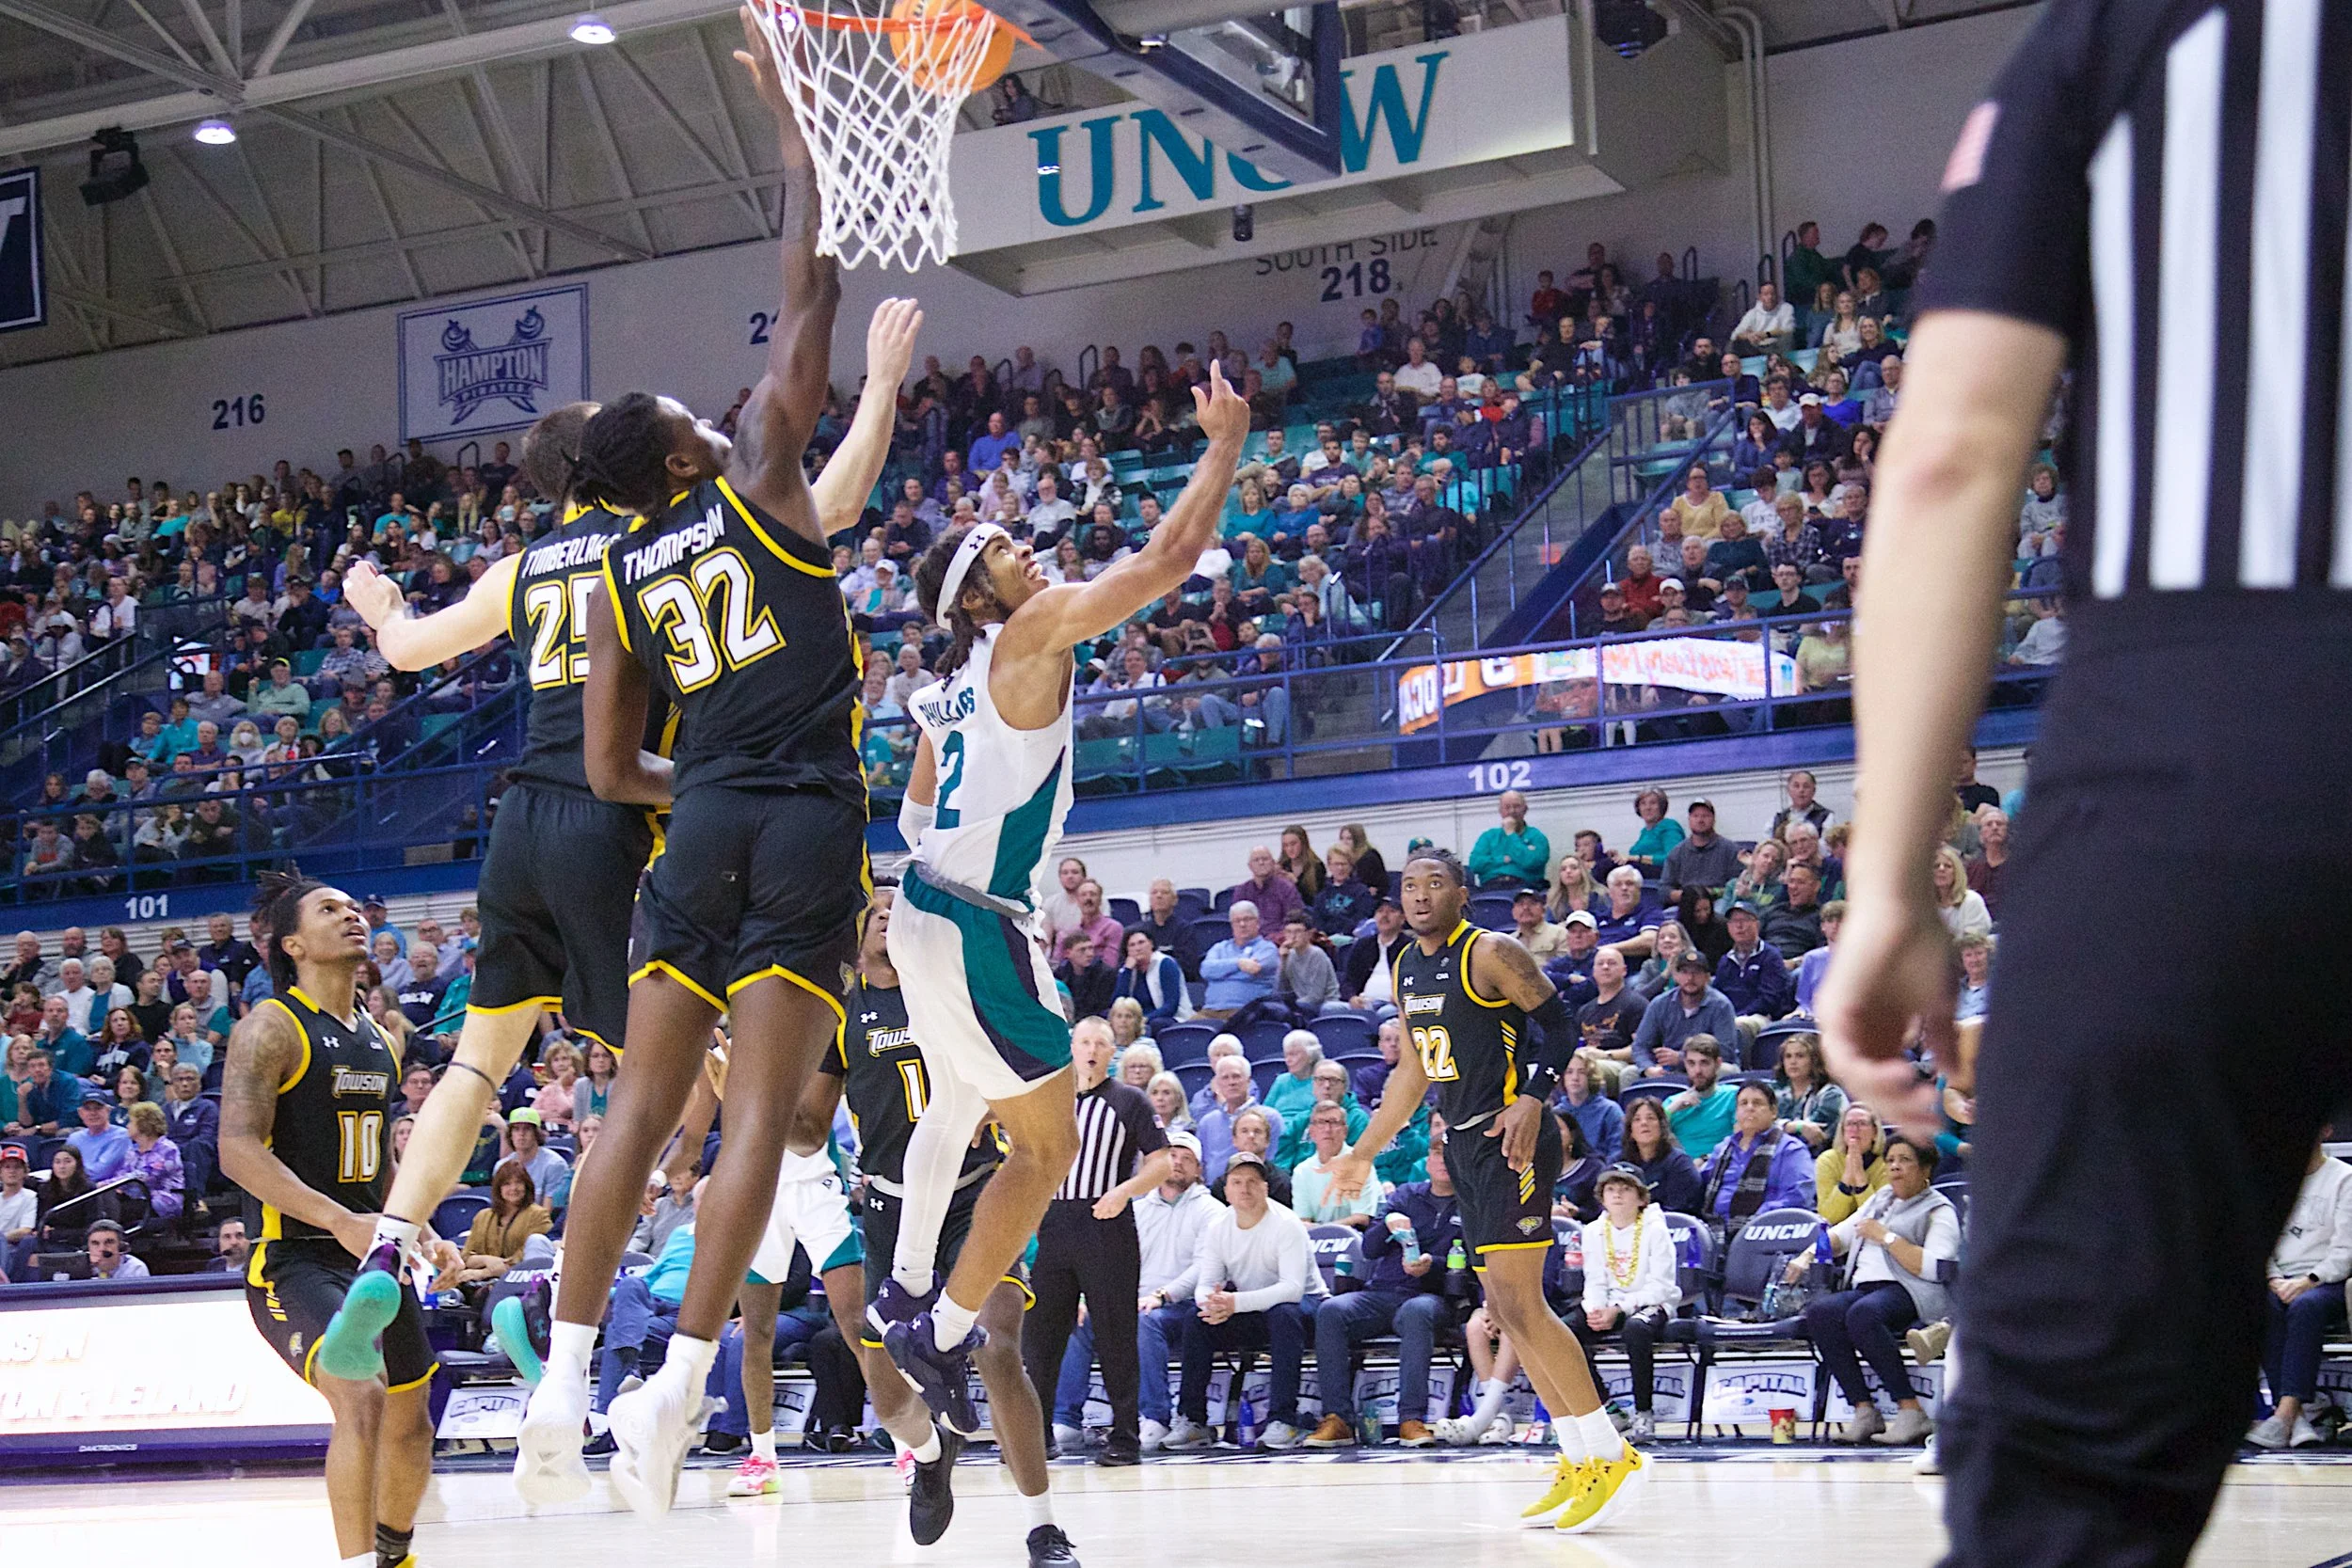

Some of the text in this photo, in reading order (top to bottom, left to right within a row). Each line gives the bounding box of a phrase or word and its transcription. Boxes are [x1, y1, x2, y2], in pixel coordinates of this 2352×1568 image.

[1255, 230, 1438, 276] SOUTH SIDE
[1320, 258, 1391, 303] 218
[442, 344, 544, 400] HAMPTON
[213, 393, 265, 430] 216
[636, 546, 787, 694] 32
[935, 730, 964, 830] 2
[1468, 760, 1532, 791] 102
[125, 894, 167, 919] 101
[1411, 1024, 1460, 1082] 22
[331, 1066, 389, 1099] TOWSON
[337, 1110, 384, 1183] 10
[1743, 1223, 1815, 1241] UNCW
[1712, 1372, 1807, 1399] CAPITAL
